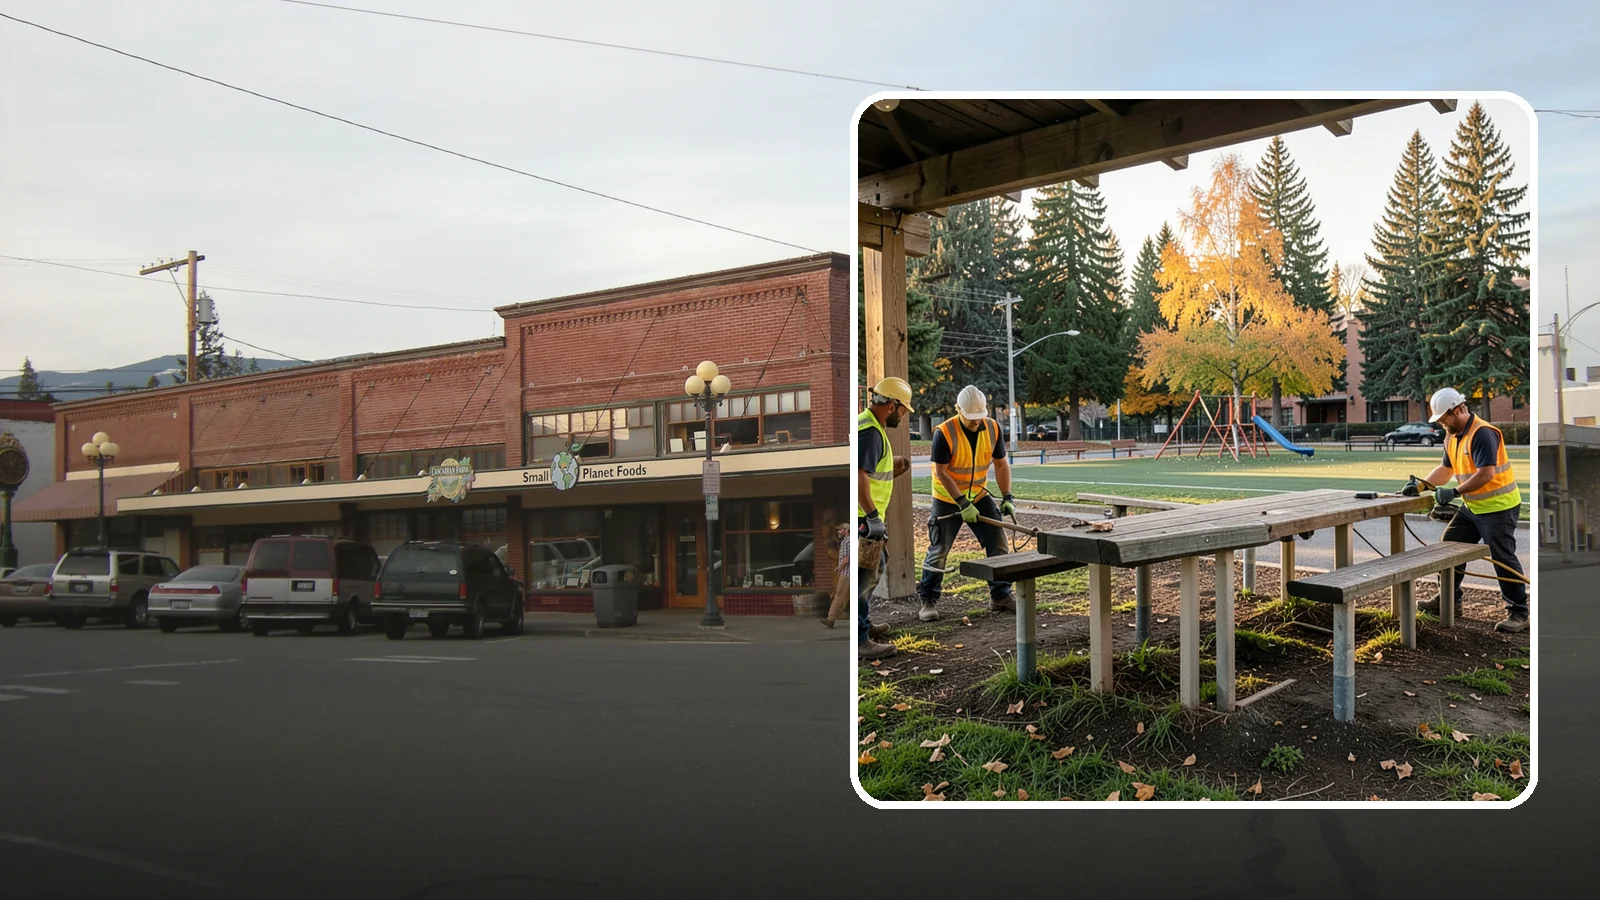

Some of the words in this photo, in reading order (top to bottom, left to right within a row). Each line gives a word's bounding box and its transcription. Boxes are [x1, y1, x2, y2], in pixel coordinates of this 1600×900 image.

[523, 471, 548, 483] Small
[583, 468, 614, 479] Planet
[617, 464, 647, 477] Foods
